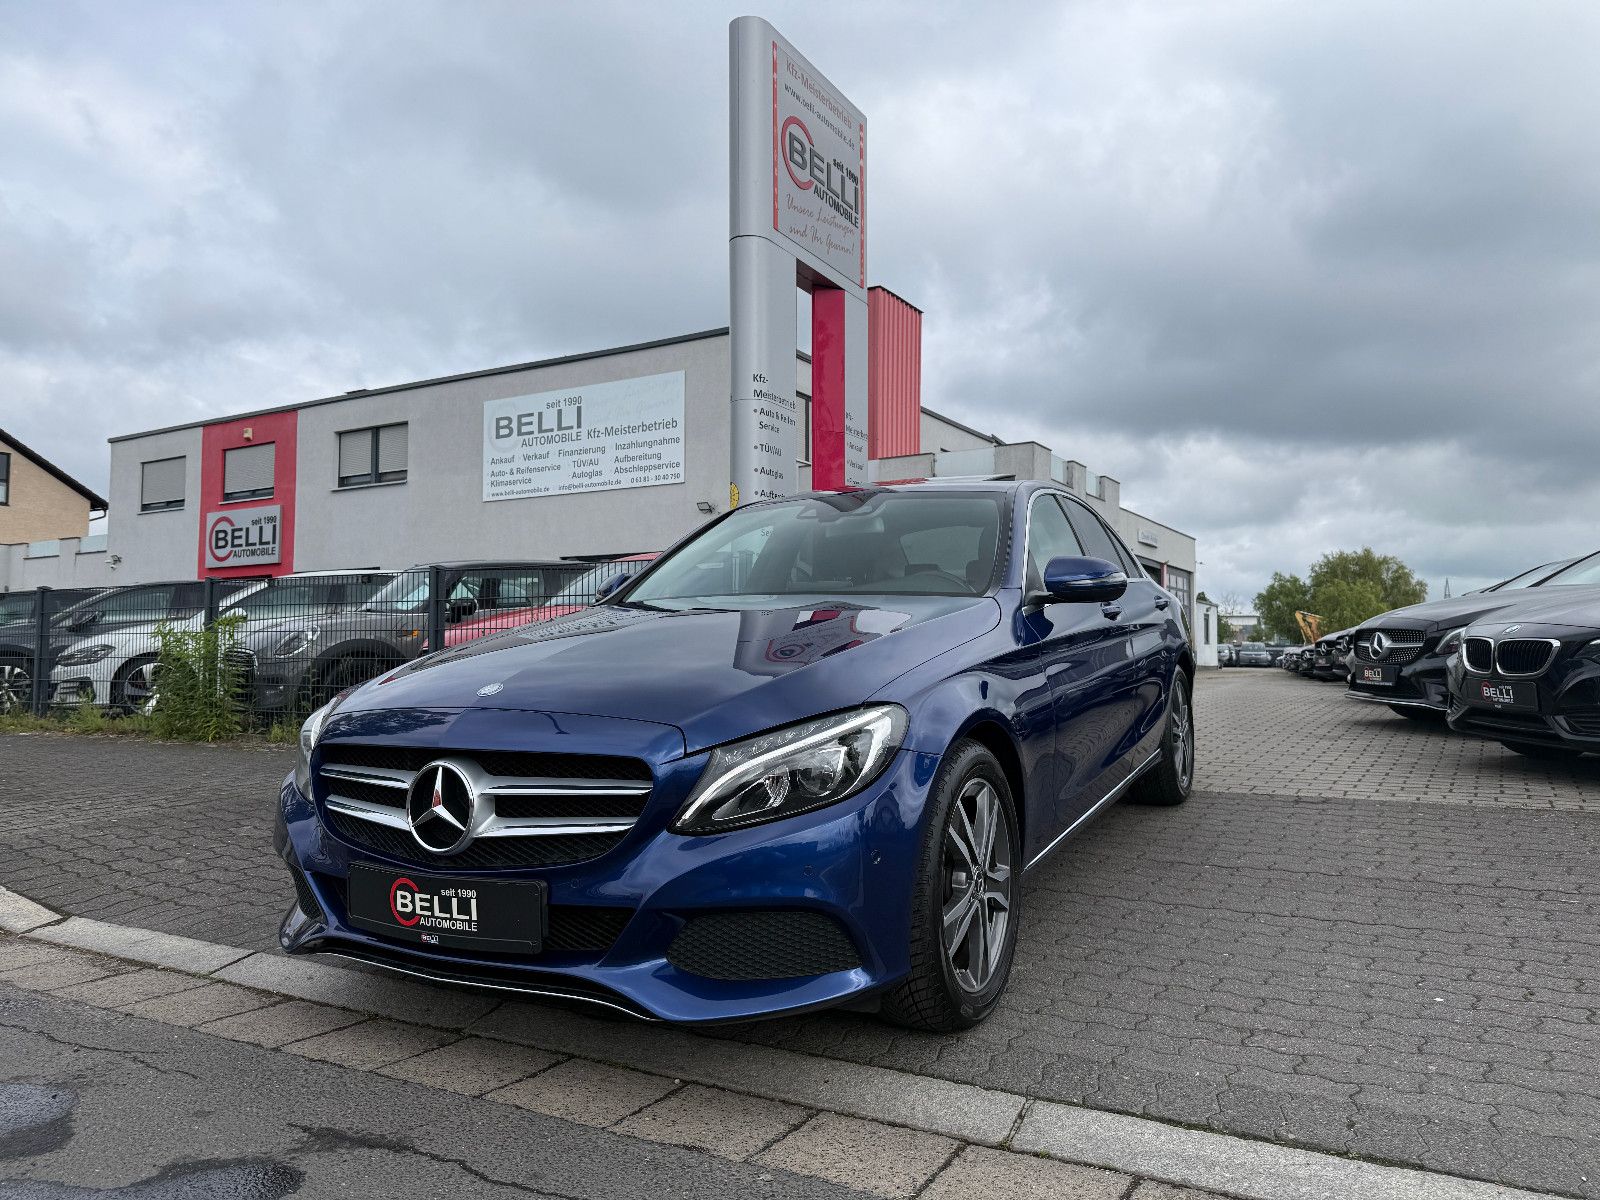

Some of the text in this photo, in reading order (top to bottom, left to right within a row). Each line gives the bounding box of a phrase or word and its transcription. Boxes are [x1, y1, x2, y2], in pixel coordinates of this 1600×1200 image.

[786, 59, 852, 129] Kfz-Meisterbetrieb
[789, 131, 859, 215] BELLI
[832, 157, 859, 187] seit 1990
[786, 193, 814, 218] Unsere
[813, 183, 859, 229] AUTOMOBILE
[789, 223, 808, 238] sind
[752, 373, 769, 384] Kfz-
[546, 395, 582, 409] seit 1990
[495, 406, 582, 439] BELLI
[587, 417, 678, 440] Kfz-Meisterbetrieb
[490, 436, 681, 466] Ankauf Verkauf Finanzierung Inzahlungnahme
[521, 431, 582, 448] AUTOMOBILE
[490, 461, 681, 488] Klimaservice Autoglas Abschleppservice
[509, 467, 514, 476] &
[516, 464, 561, 475] Reifenservice
[613, 452, 662, 465] Aufbereitung
[252, 517, 262, 526] seit
[214, 524, 277, 549] BELLI
[233, 547, 276, 558] AUTOMOBILE
[1482, 686, 1514, 699] BELLI
[397, 890, 477, 921] BELLI
[440, 888, 477, 899] seit 1990
[420, 916, 478, 931] AUTOMOBILE
